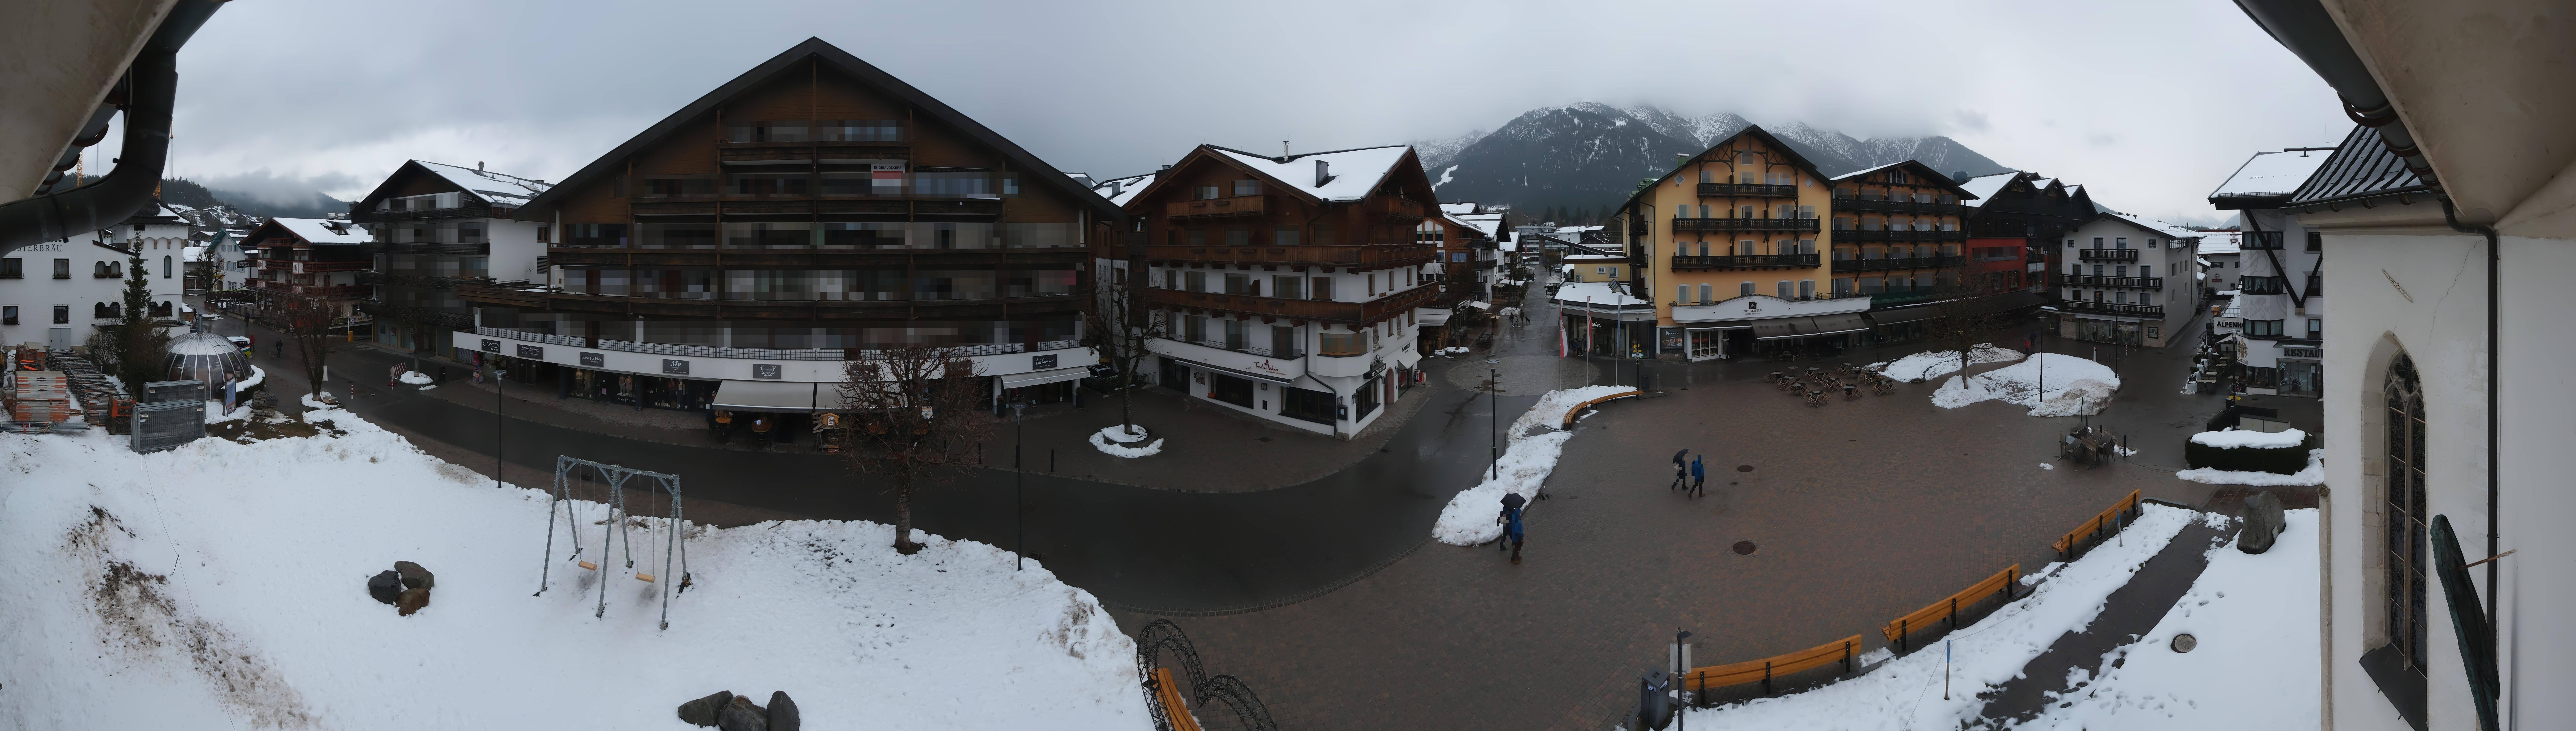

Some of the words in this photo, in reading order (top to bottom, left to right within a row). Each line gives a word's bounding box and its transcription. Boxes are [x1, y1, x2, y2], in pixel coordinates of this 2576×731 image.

[1402, 343, 1410, 352] SAILER
[670, 361, 681, 370] My
[1371, 364, 1385, 377] RESTAURANT
